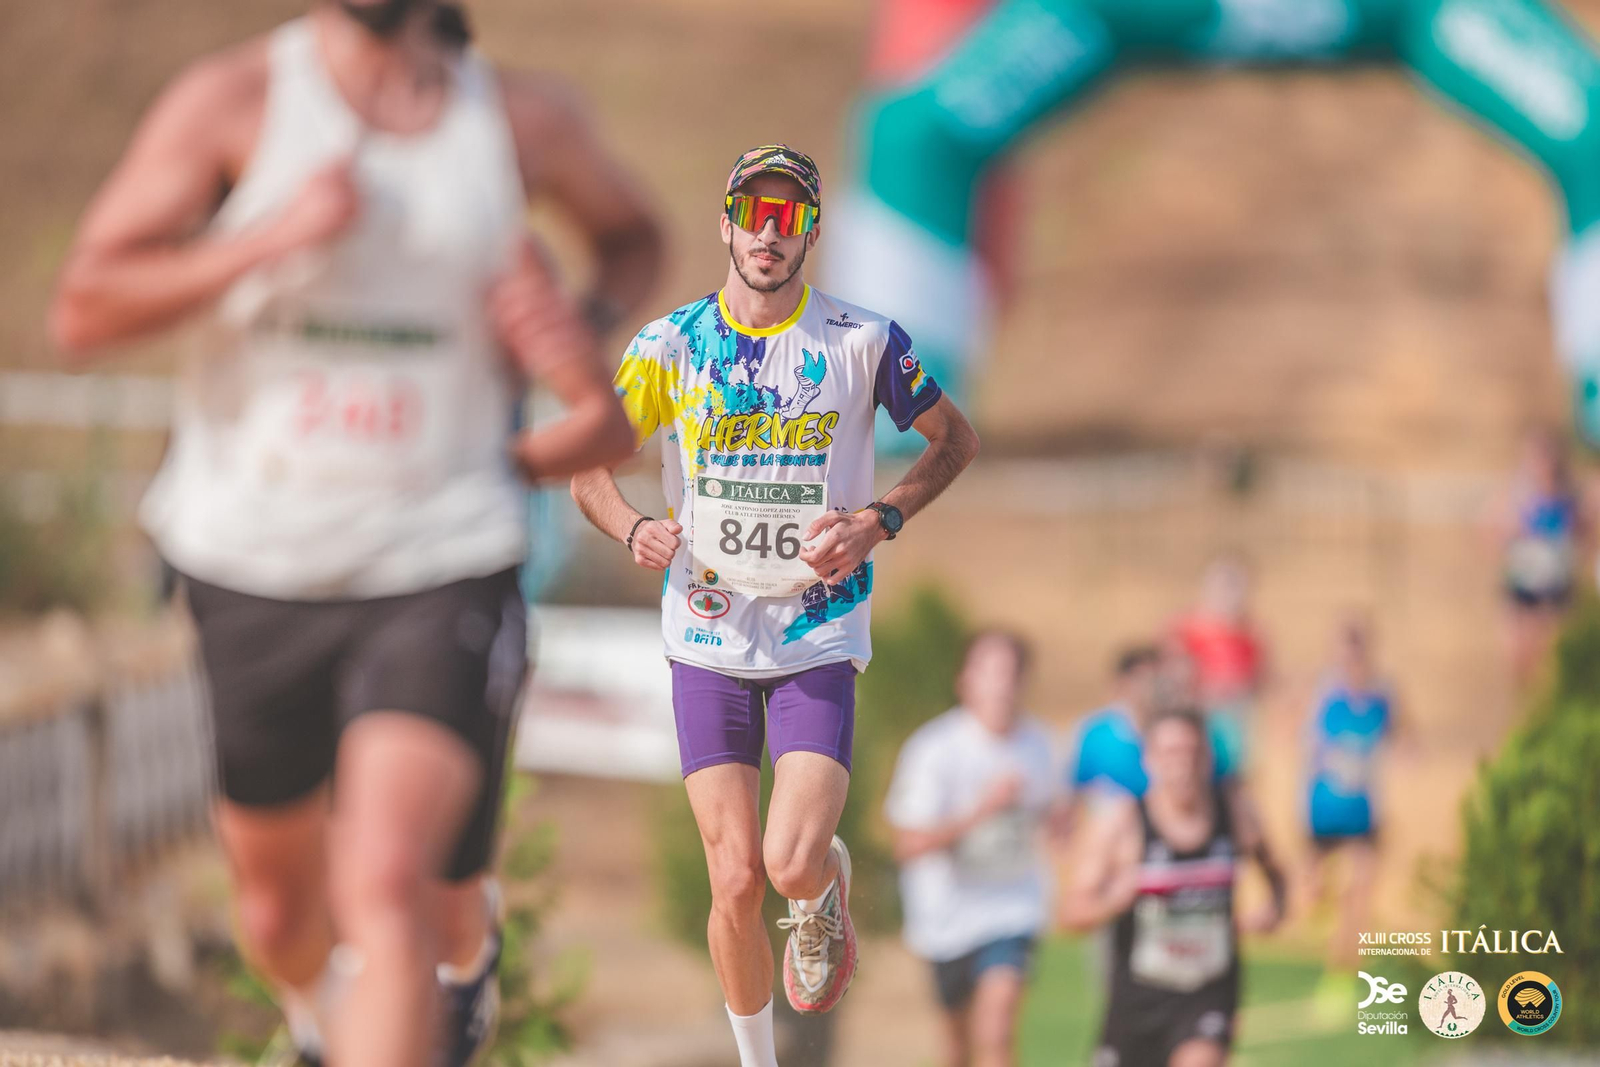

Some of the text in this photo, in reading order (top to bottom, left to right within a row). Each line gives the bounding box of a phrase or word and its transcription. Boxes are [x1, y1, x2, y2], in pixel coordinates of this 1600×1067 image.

[826, 319, 863, 329] TEAMERGY
[697, 411, 839, 452] HERMES
[710, 453, 740, 466] PALOS
[742, 453, 758, 466] DE
[760, 453, 774, 466] LA
[730, 484, 791, 500] ITÁLICA
[719, 518, 801, 560] 846
